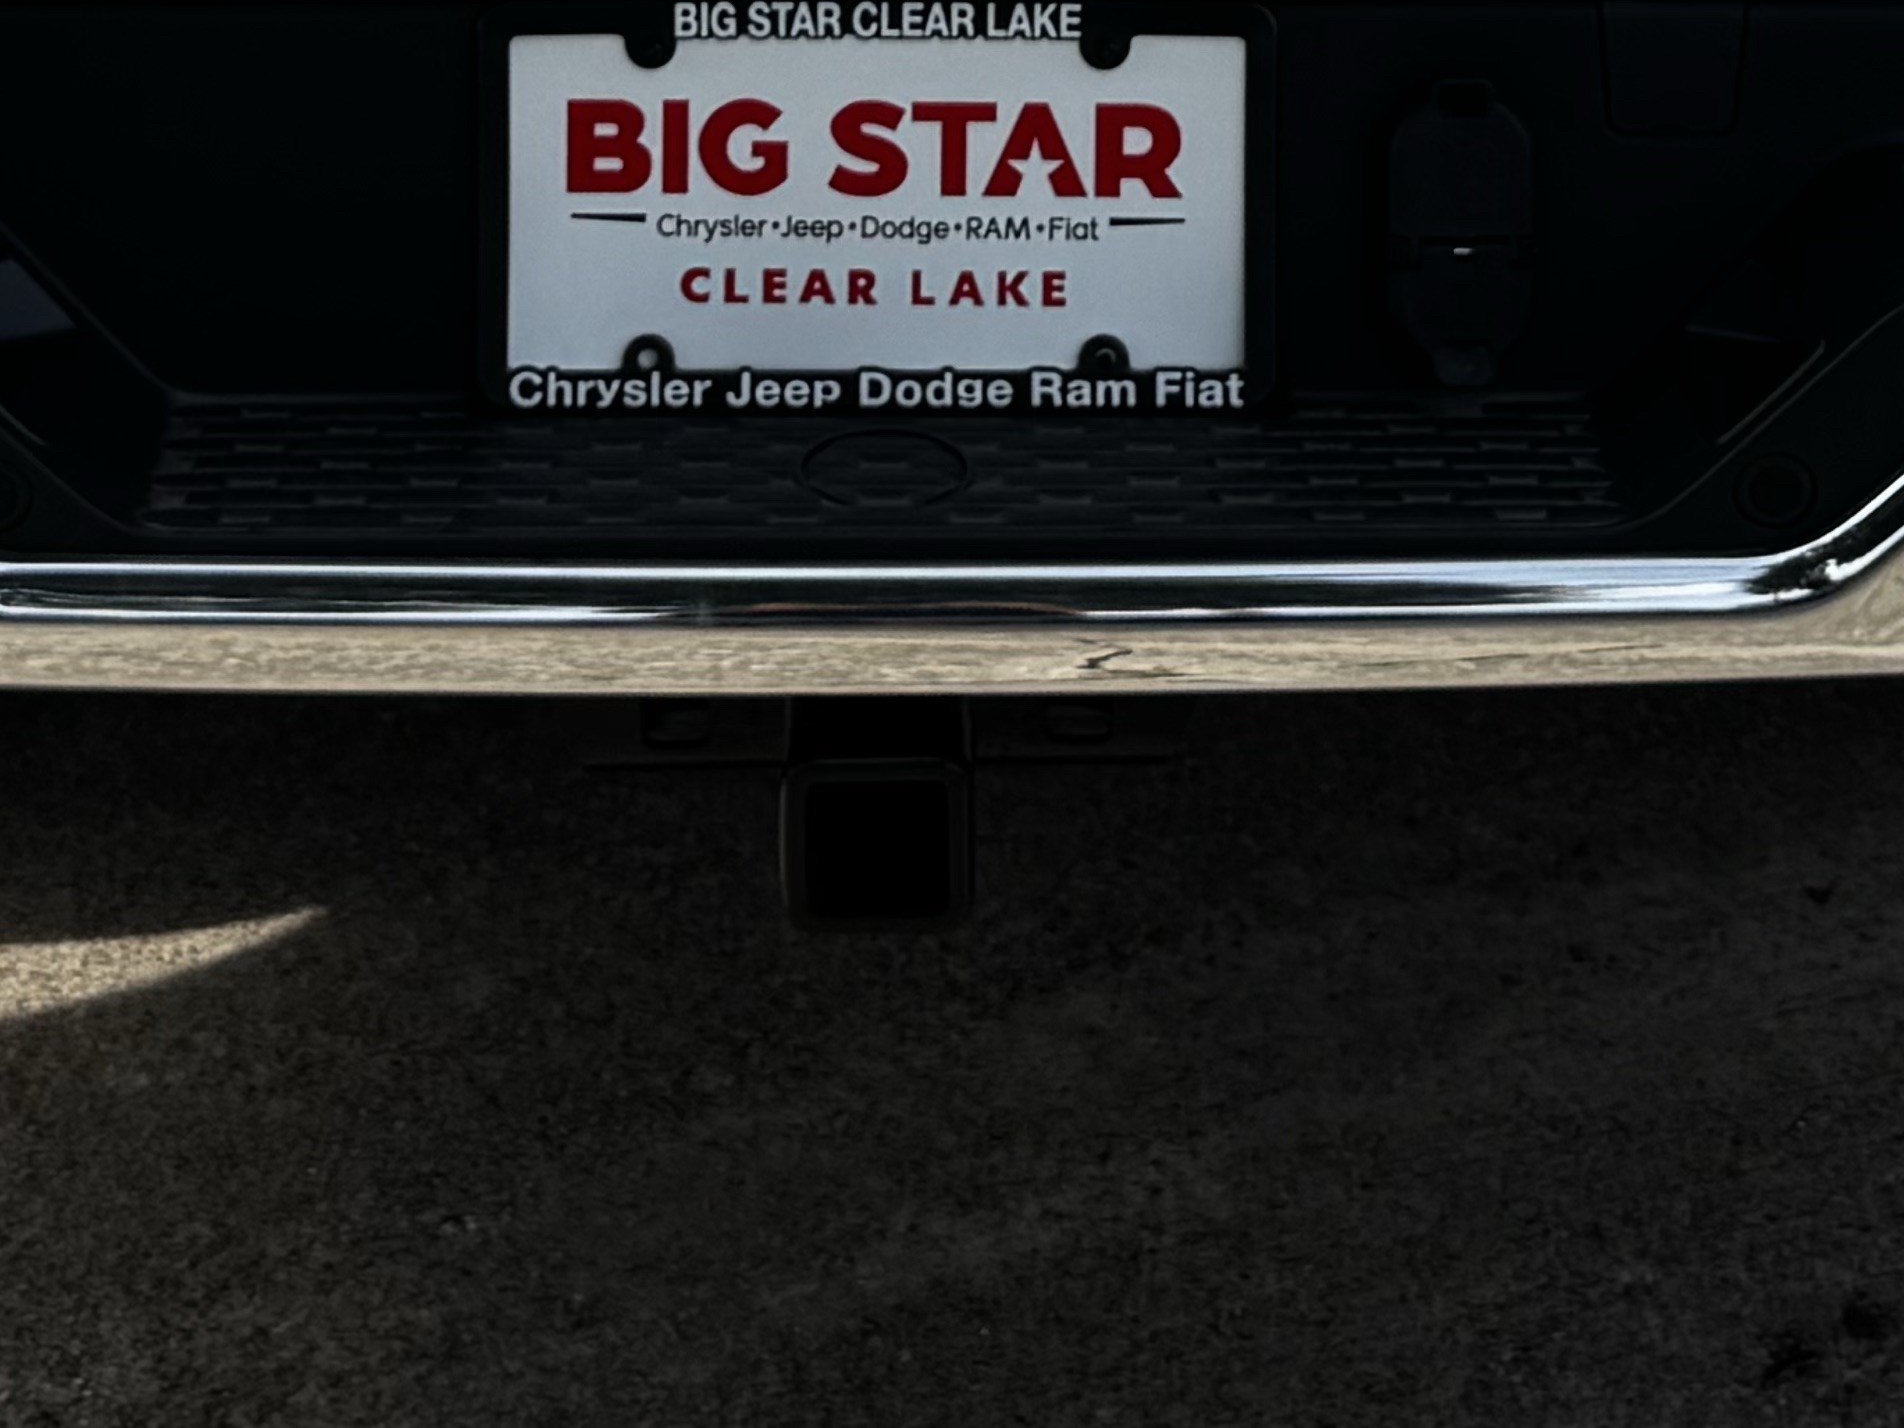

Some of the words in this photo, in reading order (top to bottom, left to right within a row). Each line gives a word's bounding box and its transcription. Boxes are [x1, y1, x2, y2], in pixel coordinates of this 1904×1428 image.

[674, 1, 738, 38] BIG
[748, 1, 843, 38] STAR
[853, 1, 976, 38] CLEAR
[986, 2, 1083, 39] LAKE
[565, 97, 790, 197] BIG
[827, 99, 1183, 199] STAR
[679, 266, 879, 306] CLEAR
[910, 268, 1068, 307] LAKE
[508, 370, 713, 408] Chrysler
[725, 370, 842, 409] Jeep
[858, 370, 1014, 409] Dodge
[1030, 370, 1137, 409] Ram
[1154, 370, 1245, 409] Fiat
